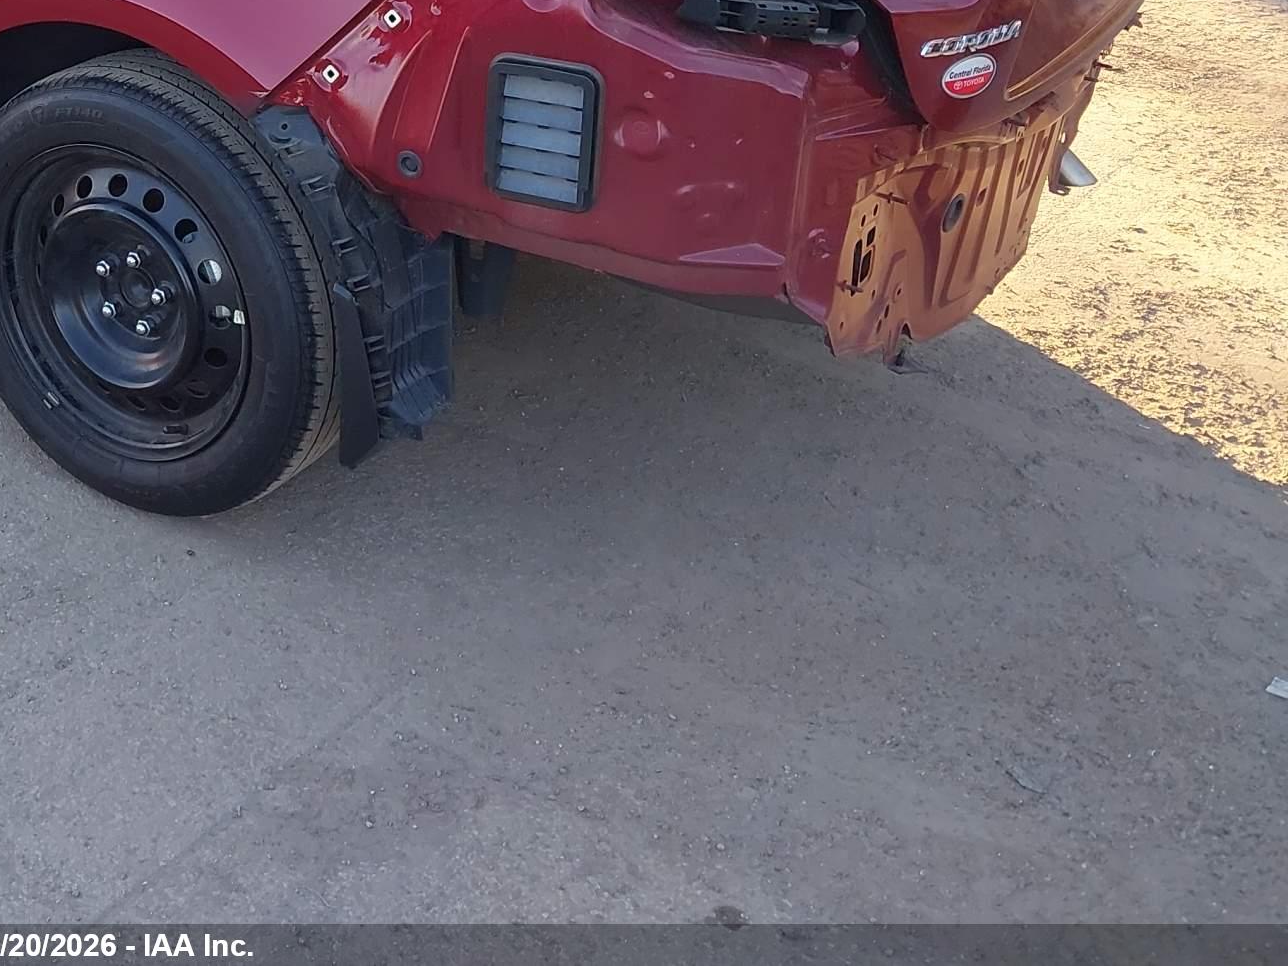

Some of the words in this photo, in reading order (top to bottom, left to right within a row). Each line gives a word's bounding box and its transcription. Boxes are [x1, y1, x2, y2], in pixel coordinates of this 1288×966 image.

[920, 20, 1022, 58] COROLLA
[949, 68, 972, 79] Central
[973, 64, 992, 75] Florida
[963, 76, 985, 87] TOYOTA
